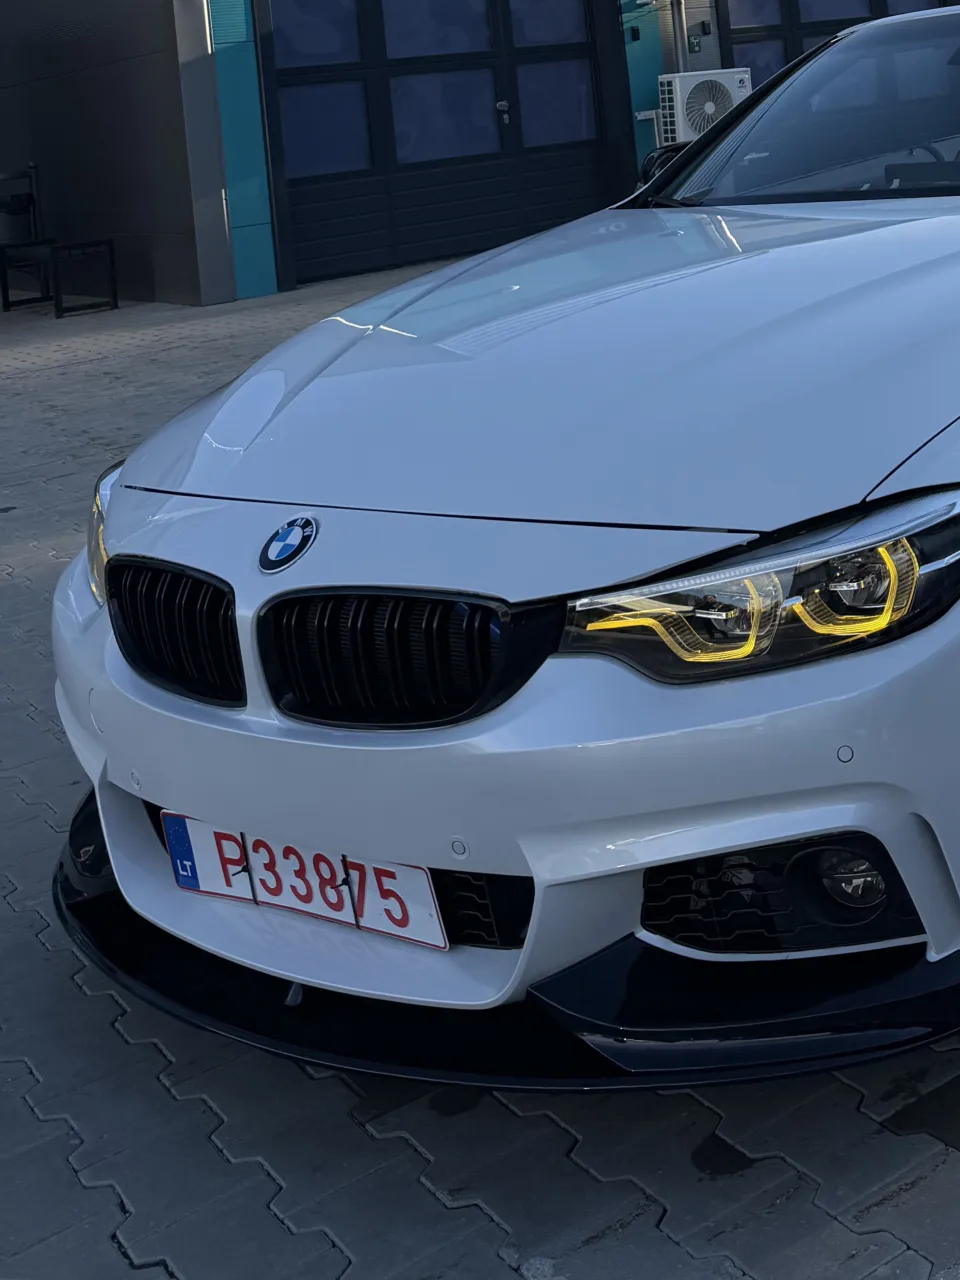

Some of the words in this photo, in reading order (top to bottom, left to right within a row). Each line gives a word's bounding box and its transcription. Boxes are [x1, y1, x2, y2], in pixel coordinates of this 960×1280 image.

[278, 517, 314, 537] BMW
[176, 859, 193, 877] LT
[212, 830, 410, 928] P33875
